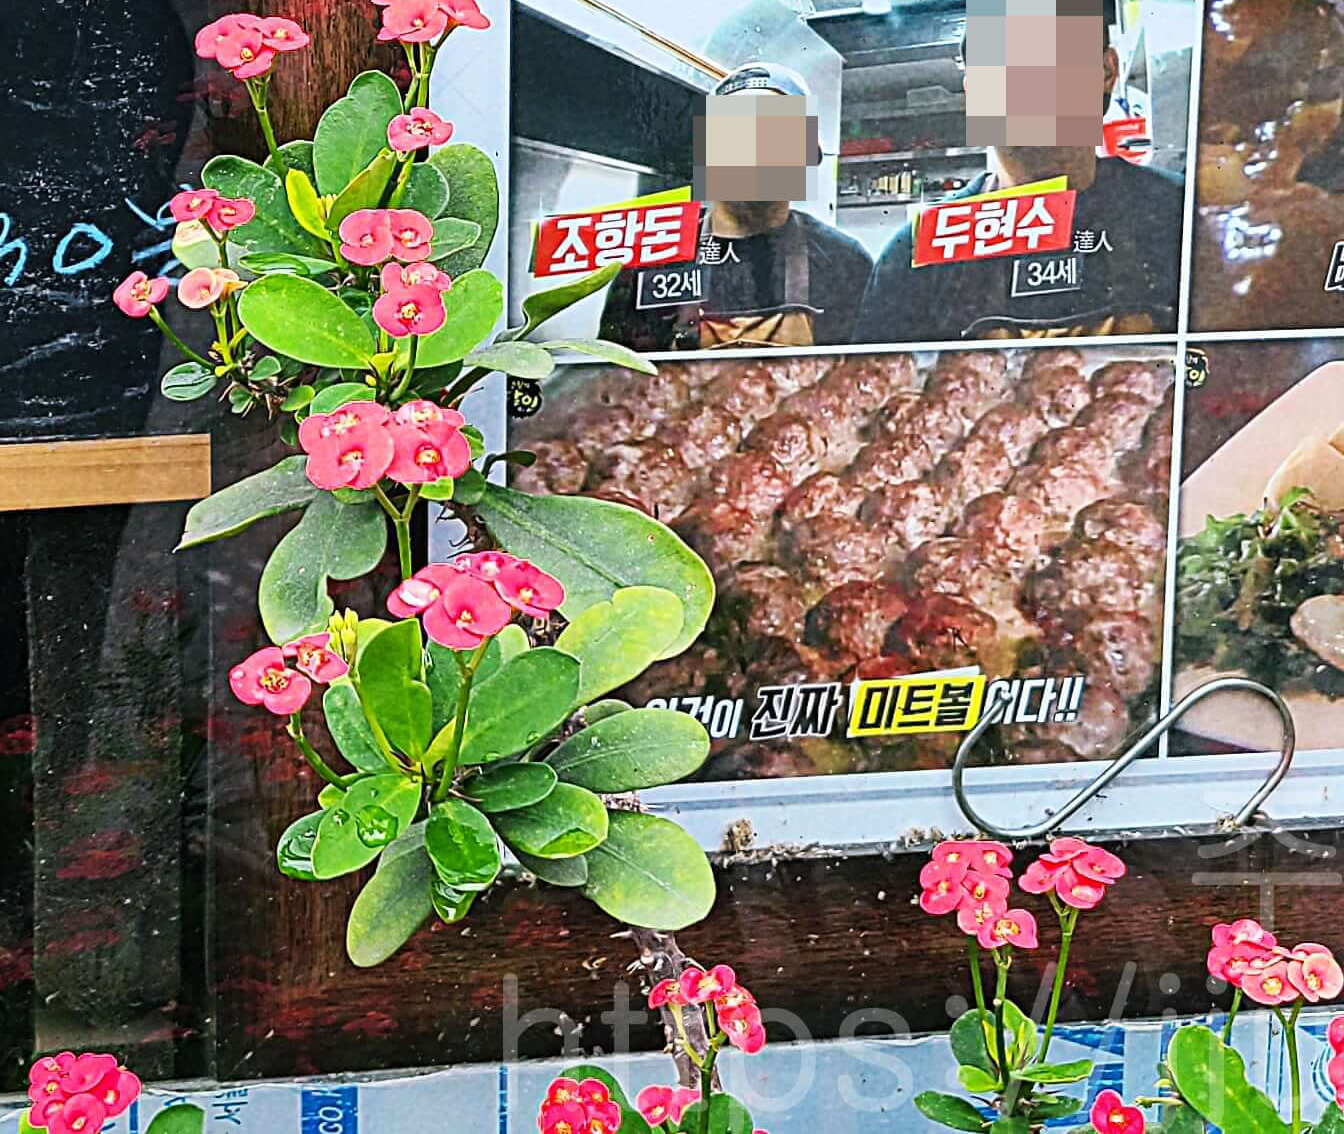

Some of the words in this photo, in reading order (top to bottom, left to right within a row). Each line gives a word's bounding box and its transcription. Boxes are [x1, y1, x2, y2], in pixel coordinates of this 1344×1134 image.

[549, 206, 684, 274] 조항돈
[932, 196, 1055, 259] 두현수
[1073, 229, 1113, 254] 達人
[698, 240, 741, 265] 達人
[652, 269, 702, 298] 32세
[1027, 257, 1077, 287] 34세
[751, 682, 844, 739] 진짜
